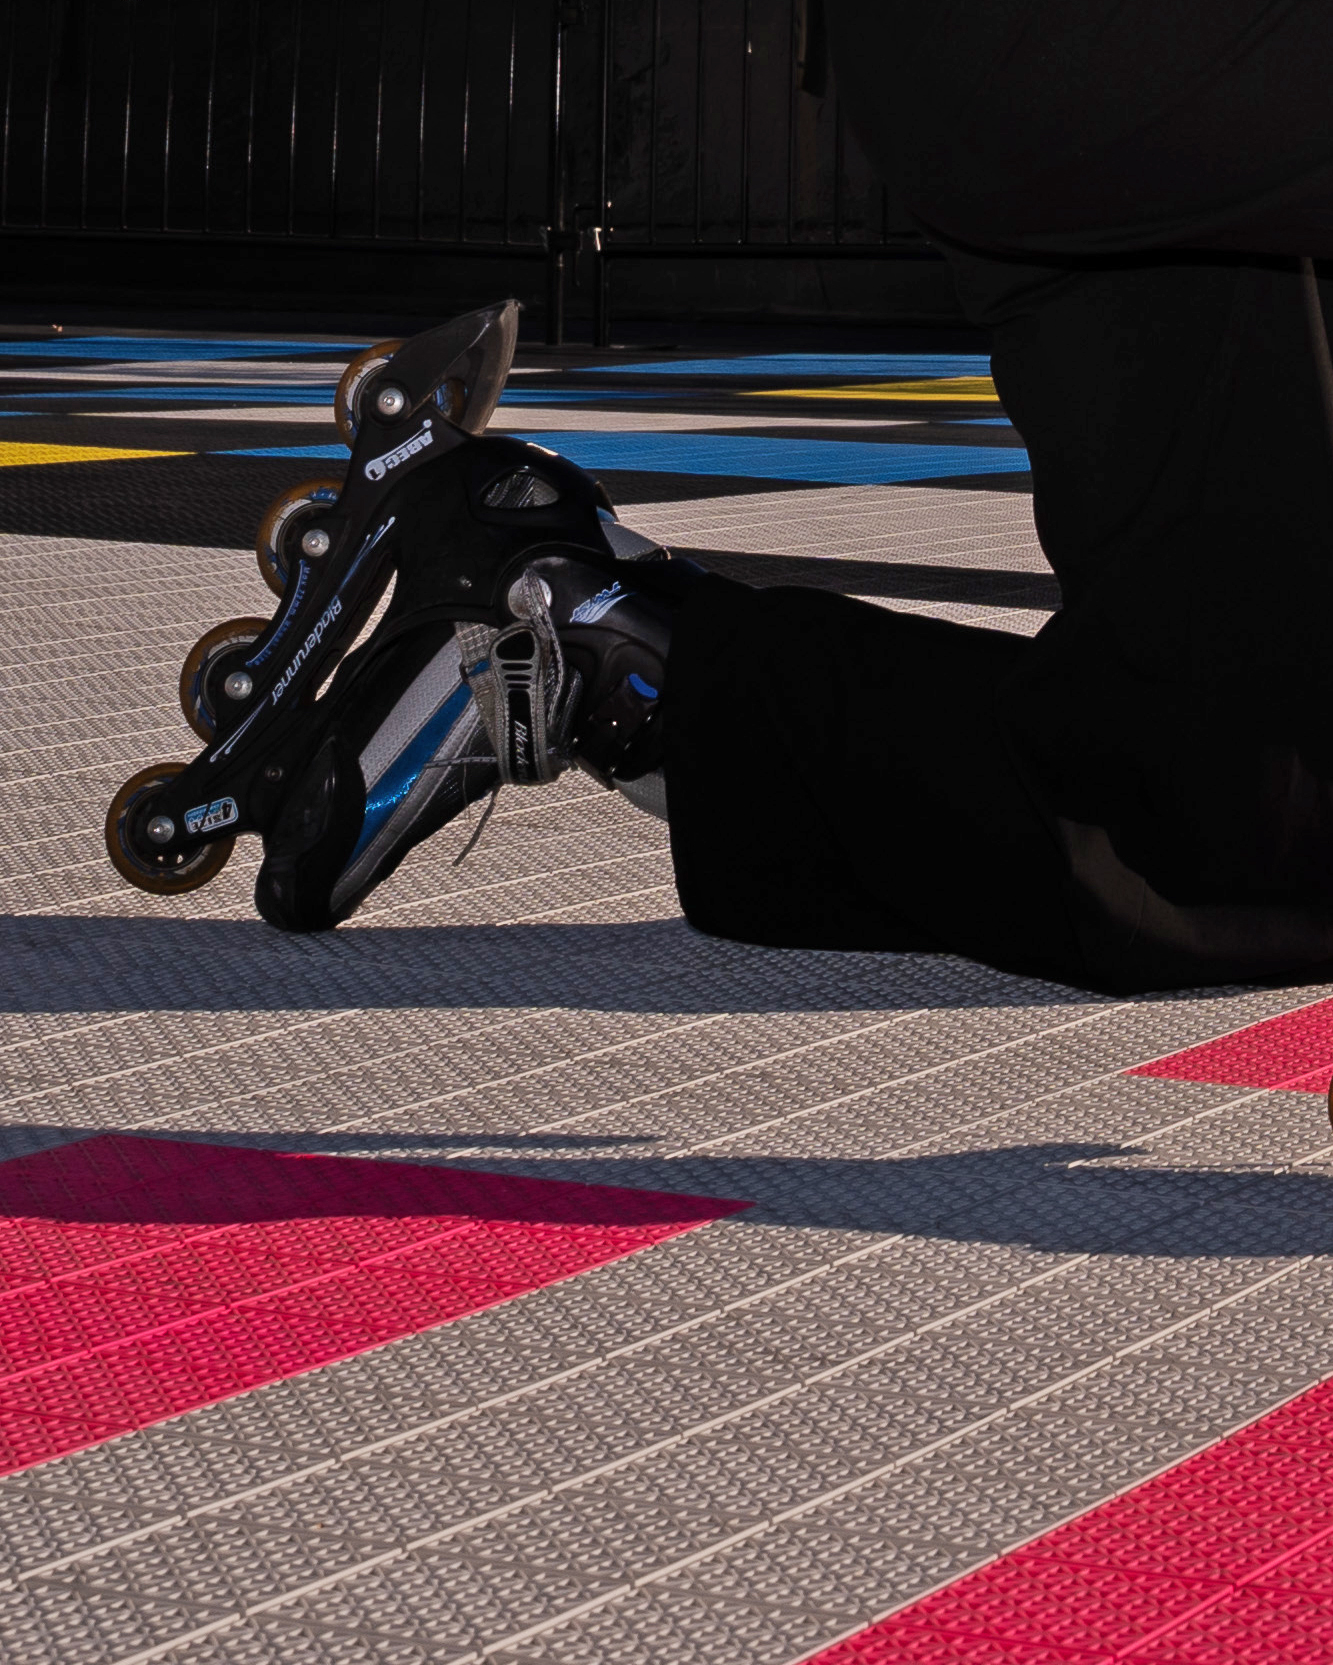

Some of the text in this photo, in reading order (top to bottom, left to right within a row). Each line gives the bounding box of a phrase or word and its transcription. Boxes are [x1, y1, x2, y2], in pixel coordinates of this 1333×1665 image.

[385, 430, 434, 469] ABEC
[271, 594, 342, 706] Bladerunner
[221, 802, 233, 820] 4
